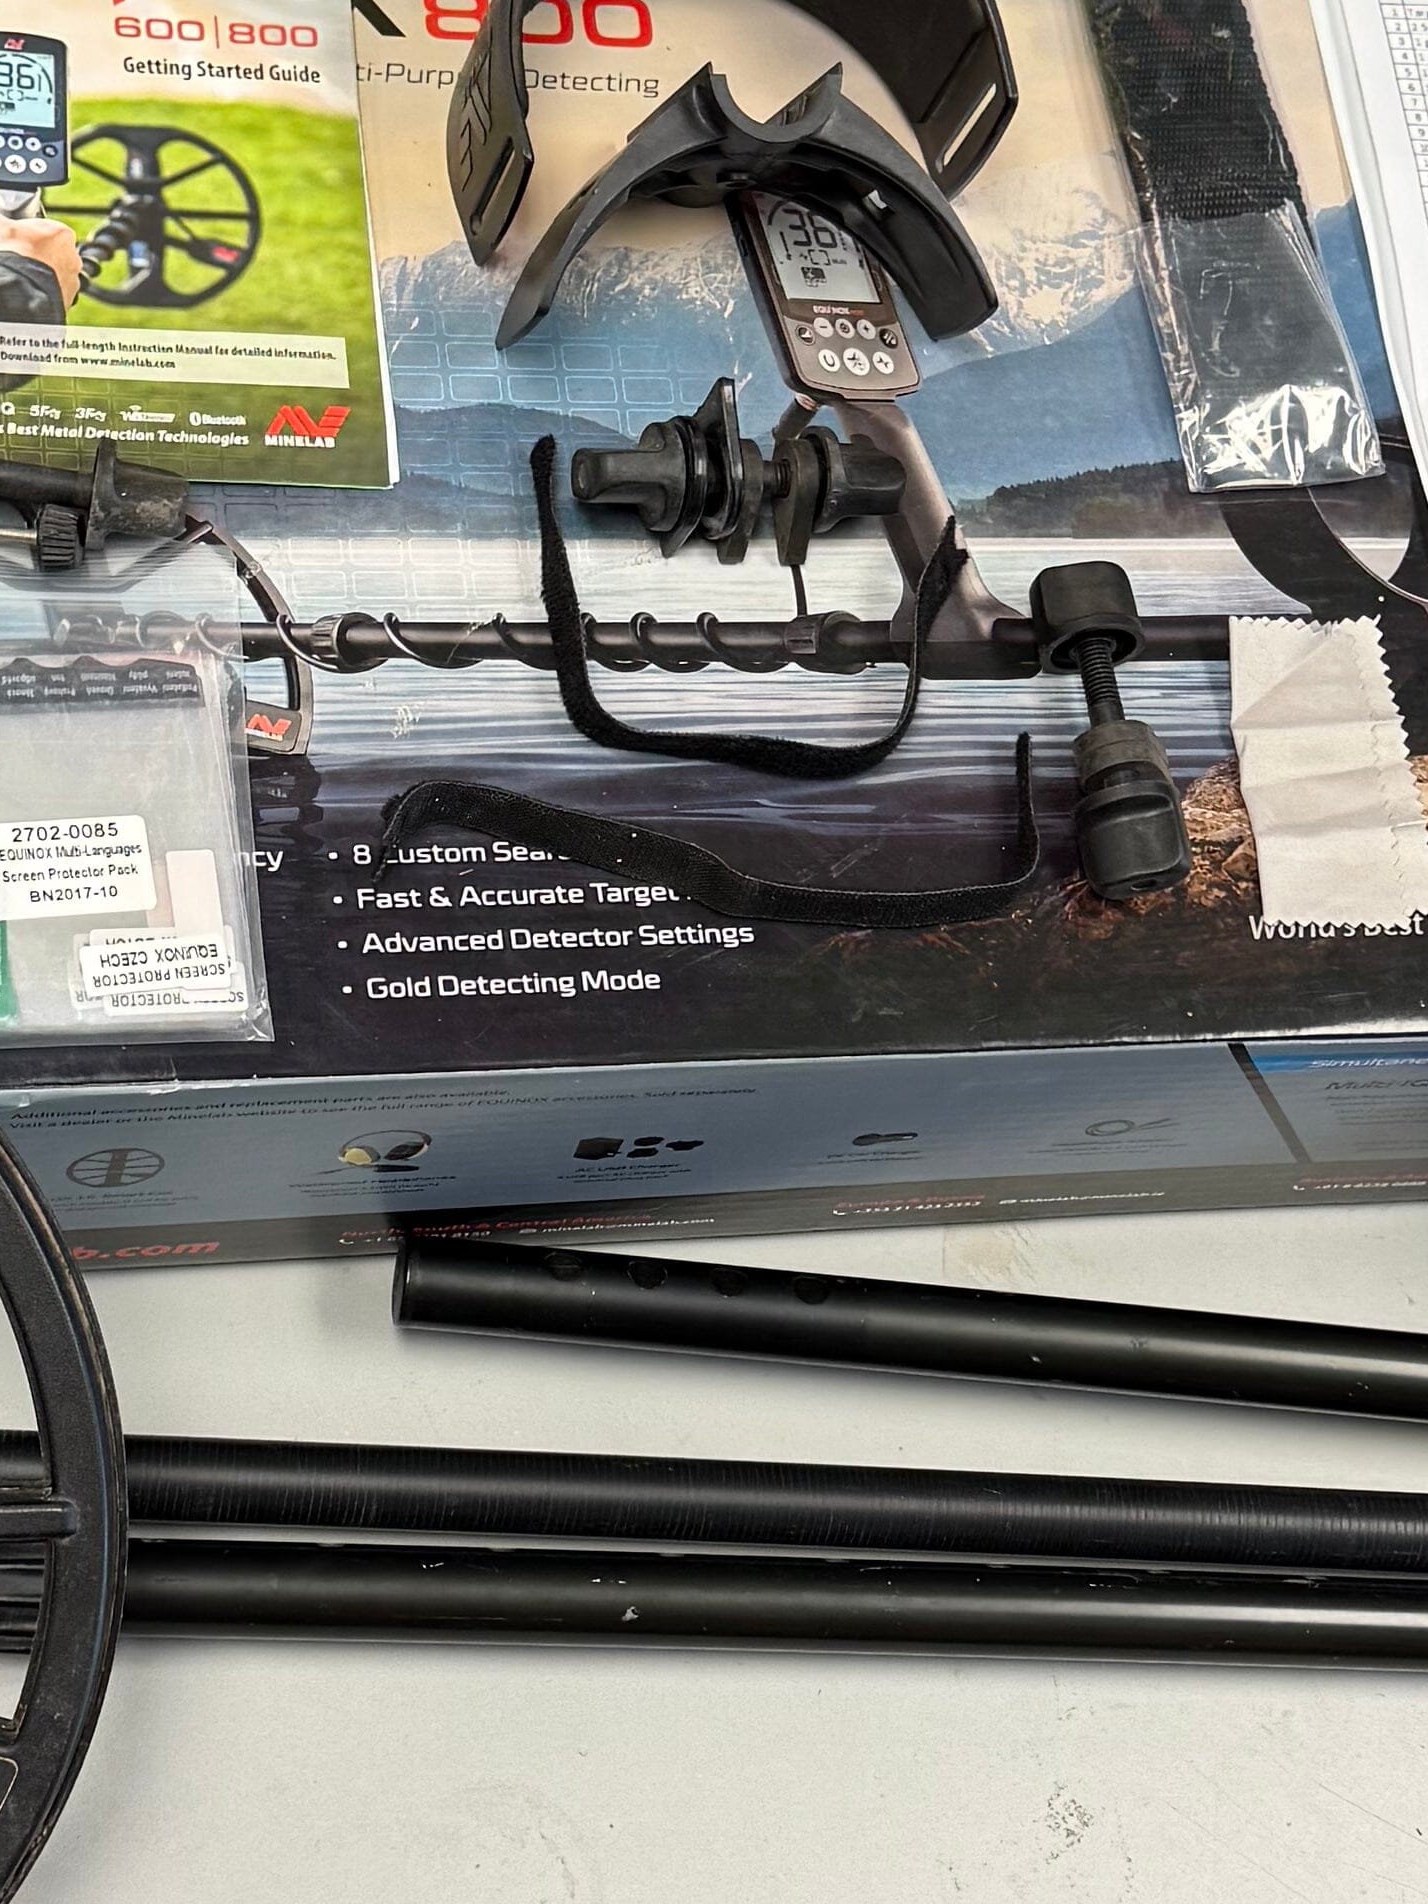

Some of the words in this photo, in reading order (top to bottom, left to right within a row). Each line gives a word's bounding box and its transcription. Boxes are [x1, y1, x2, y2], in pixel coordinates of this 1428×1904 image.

[122, 56, 192, 79] Getting
[196, 59, 264, 81] Started
[269, 63, 322, 84] Guide
[523, 69, 660, 98] Detecting
[0, 336, 27, 347] Refer
[29, 338, 40, 348] to
[42, 339, 59, 348] the
[118, 343, 173, 354] Instruction
[175, 345, 213, 355] Manual
[215, 346, 229, 355] for
[231, 347, 272, 357] detailed
[274, 348, 337, 360] information.
[0, 351, 52, 364] Download
[53, 354, 79, 365] from
[81, 356, 176, 369] www.minelab.com
[7, 422, 38, 436] Best
[40, 424, 83, 439] Metal
[85, 425, 155, 442] Detection
[157, 429, 249, 447] Technologies
[264, 435, 336, 448] MINELAB
[11, 822, 119, 843] 2702-0085
[55, 842, 143, 860] Multi-Languages
[352, 844, 372, 865] 8
[386, 842, 487, 864] ustom
[2, 867, 45, 883] Screen
[47, 865, 105, 880] Protector
[108, 863, 138, 877] Pack
[28, 885, 119, 903] BN2017-10
[357, 887, 422, 910] Fast
[428, 886, 453, 907] &
[459, 885, 585, 907] Accurate
[361, 929, 504, 954] Advanced
[510, 928, 634, 950] Detector
[638, 924, 755, 950] Settings
[99, 950, 149, 968] CZECH
[156, 943, 218, 961] EQUINOX
[93, 967, 171, 987] PROTECTOR
[175, 961, 226, 980] SCREEN
[366, 975, 431, 1000] Gold
[437, 972, 576, 999] Detecting
[581, 970, 661, 992] Mode
[10, 1109, 96, 1119] Additional
